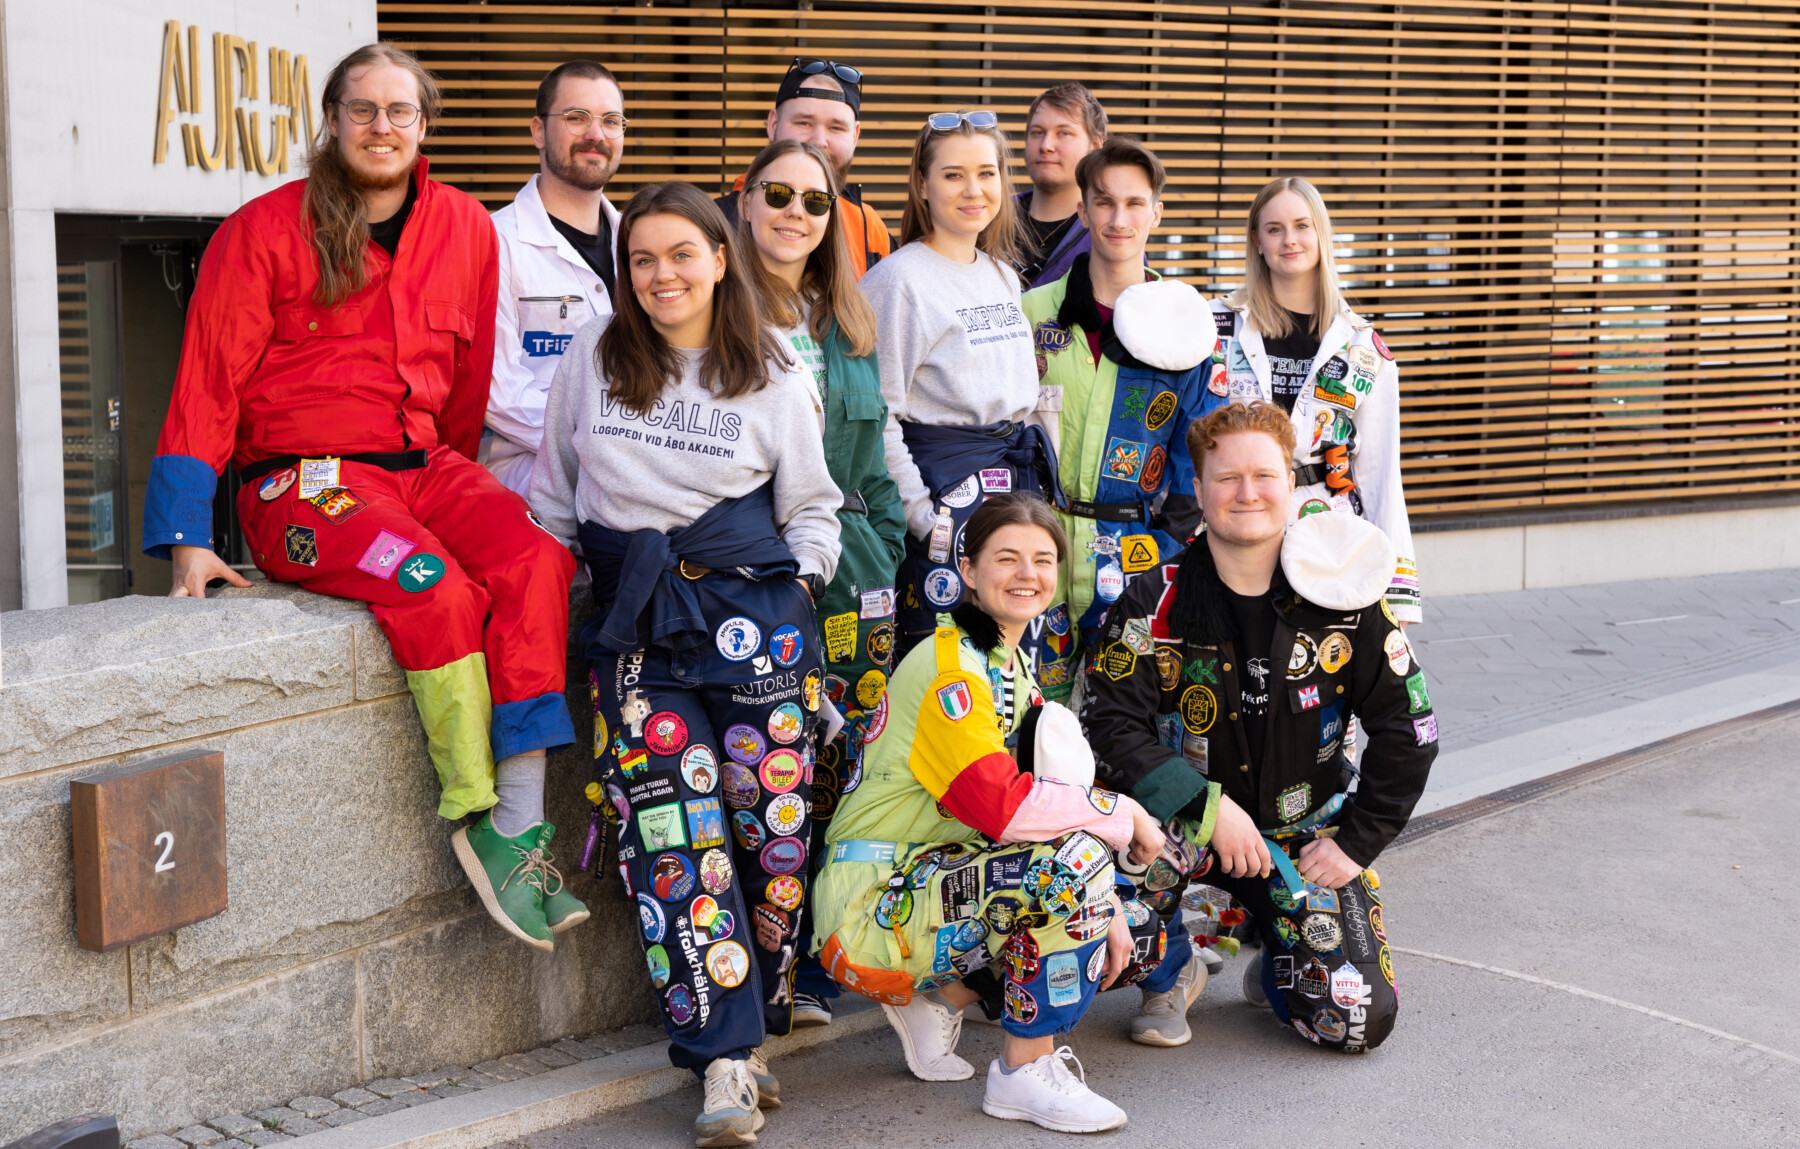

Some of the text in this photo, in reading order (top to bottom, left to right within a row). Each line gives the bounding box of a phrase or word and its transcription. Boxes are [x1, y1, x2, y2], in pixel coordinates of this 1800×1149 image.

[154, 19, 317, 176] AURUM
[956, 303, 1021, 332] IMPULS
[1040, 331, 1064, 344] 100
[1352, 374, 1372, 396] 100
[592, 425, 734, 460] LOGOPEDI VID ÅBO AKADEMI
[408, 562, 437, 584] K
[720, 620, 744, 638] IMPULS
[773, 630, 800, 642] VOCALIS
[730, 671, 797, 694] TUTORIS
[940, 682, 964, 697] ITALIA
[732, 687, 800, 705] ERIKOISKUNTOUTUS
[650, 733, 687, 753] Jättehjärna!
[630, 778, 668, 794] MAKE TURKU
[772, 776, 792, 784] BILEET
[630, 786, 674, 804] CAPITAL AGAIN
[686, 802, 704, 814] Back
[778, 818, 802, 834] ANNIVERSARY
[154, 832, 176, 873] 2
[992, 861, 1004, 882] DROP
[716, 916, 731, 932] TURKU
[1307, 922, 1336, 936] AURA
[936, 934, 951, 972] PUNG
